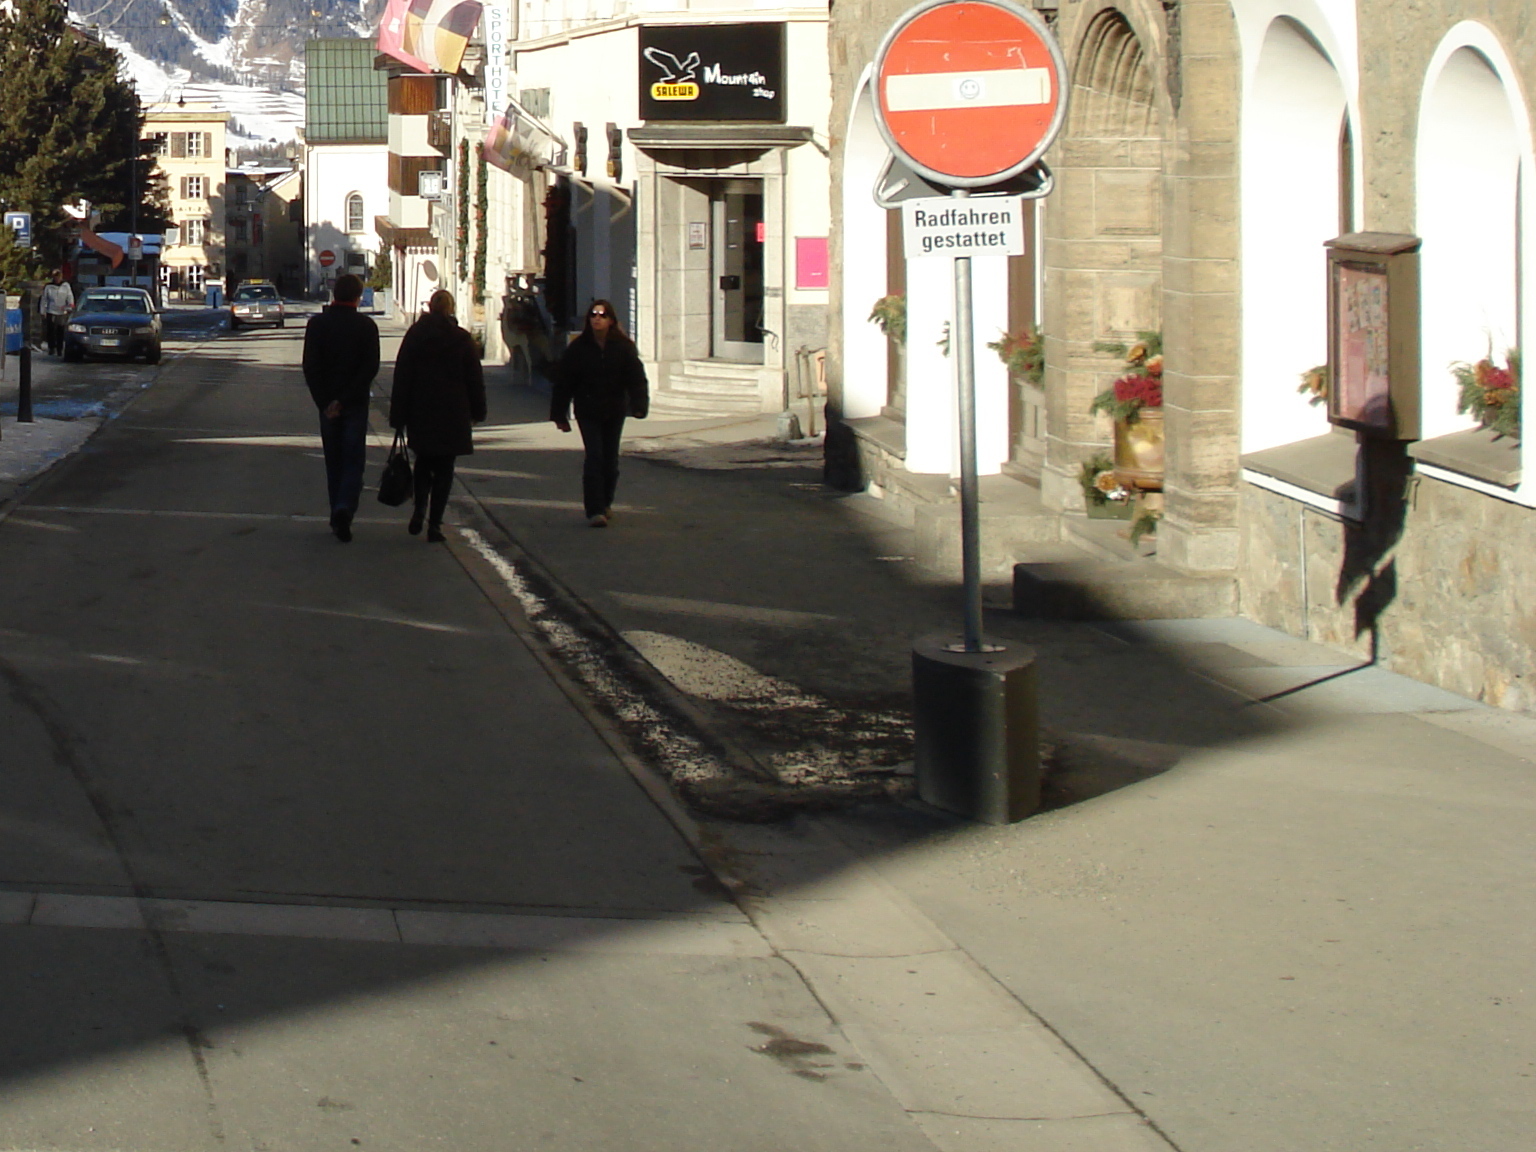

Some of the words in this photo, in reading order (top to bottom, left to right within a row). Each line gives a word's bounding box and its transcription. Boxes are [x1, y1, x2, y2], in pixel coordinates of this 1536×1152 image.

[703, 62, 767, 86] Mountain
[655, 86, 695, 97] SALEWA
[752, 87, 776, 100] shop
[12, 217, 25, 232] P
[914, 208, 1012, 228] Radfahren
[922, 230, 1007, 253] gestattet
